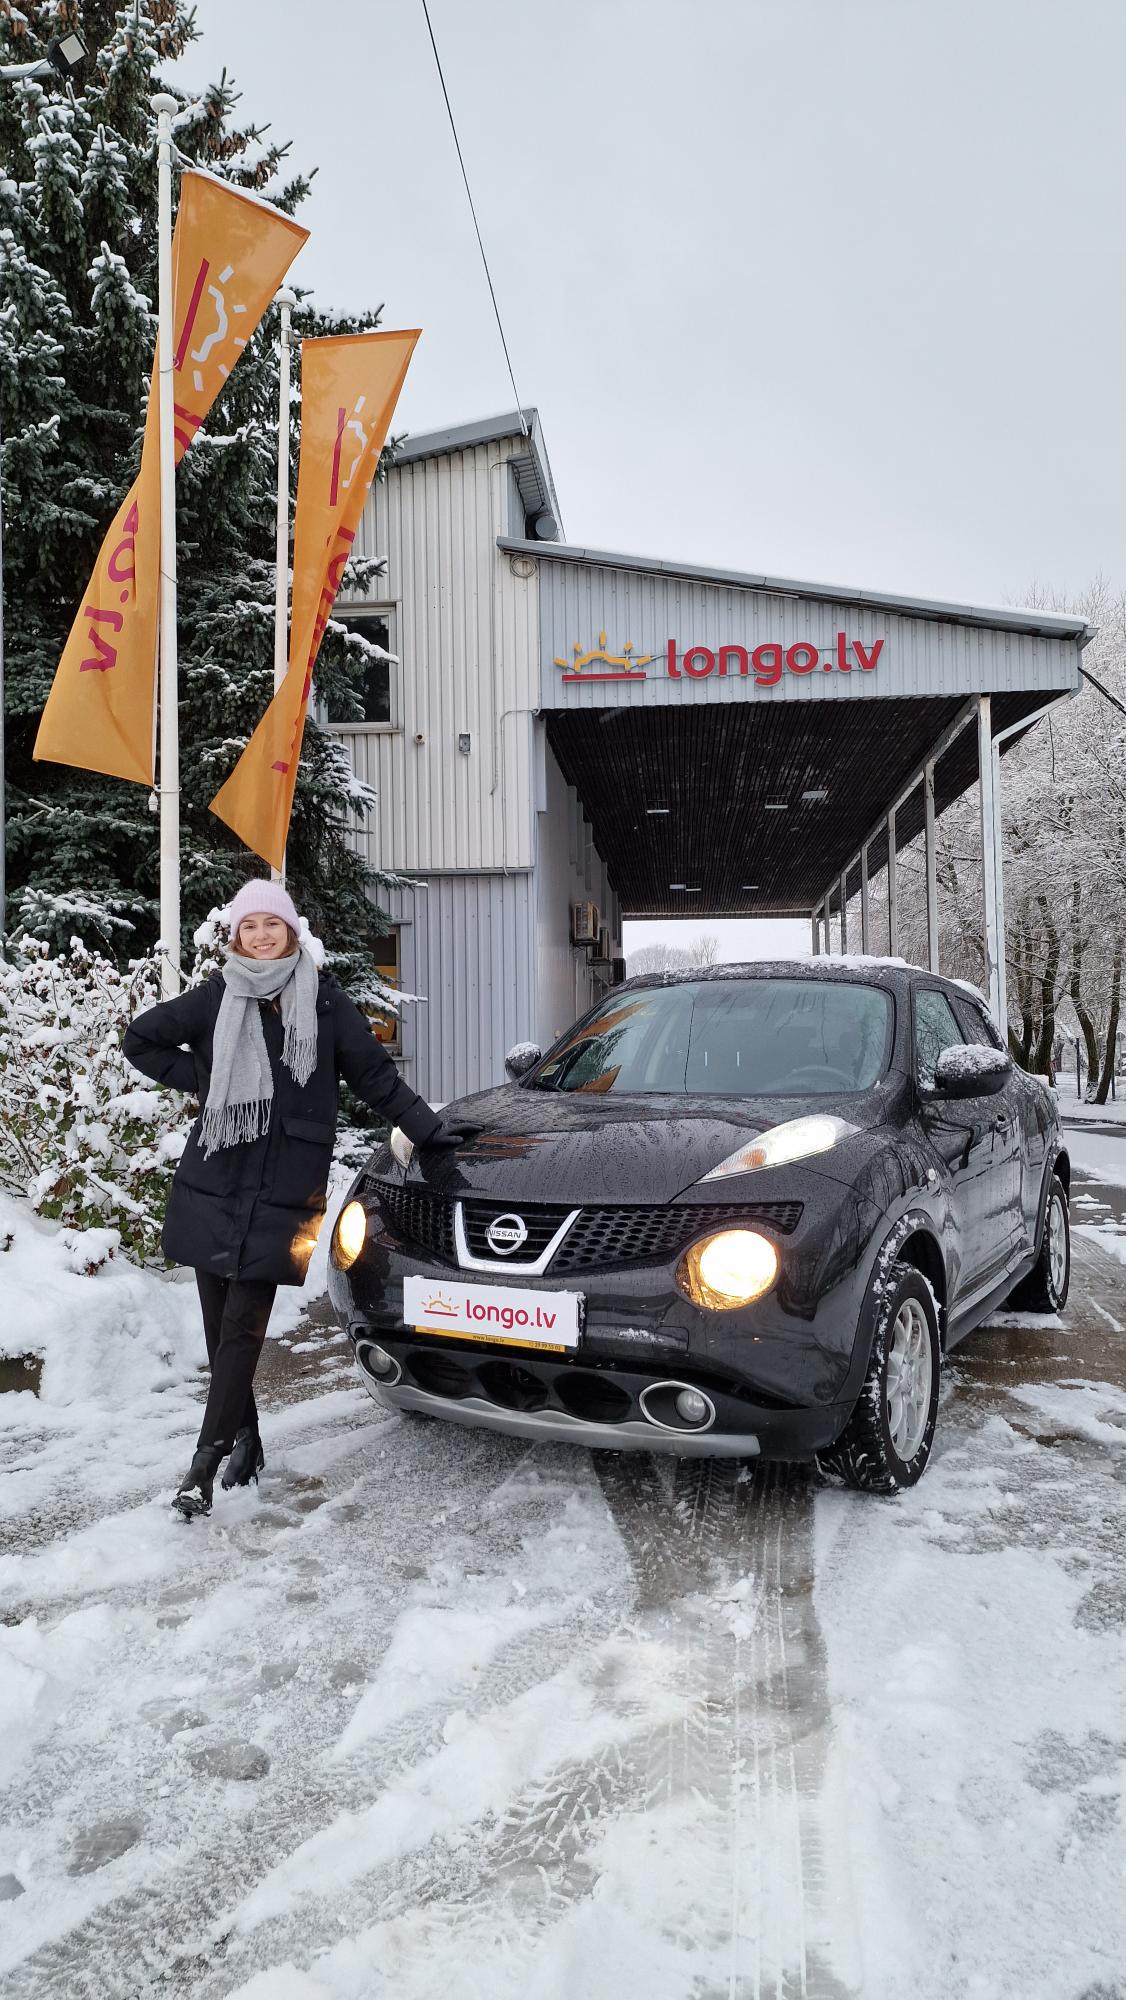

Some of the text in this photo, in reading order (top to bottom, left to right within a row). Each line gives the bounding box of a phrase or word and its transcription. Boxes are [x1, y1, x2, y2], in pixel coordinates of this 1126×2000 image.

[667, 631, 885, 688] longo.lv
[486, 1229, 522, 1239] NISSAN
[466, 1299, 557, 1329] longo.lv
[472, 1335, 505, 1343] www.longo.lv
